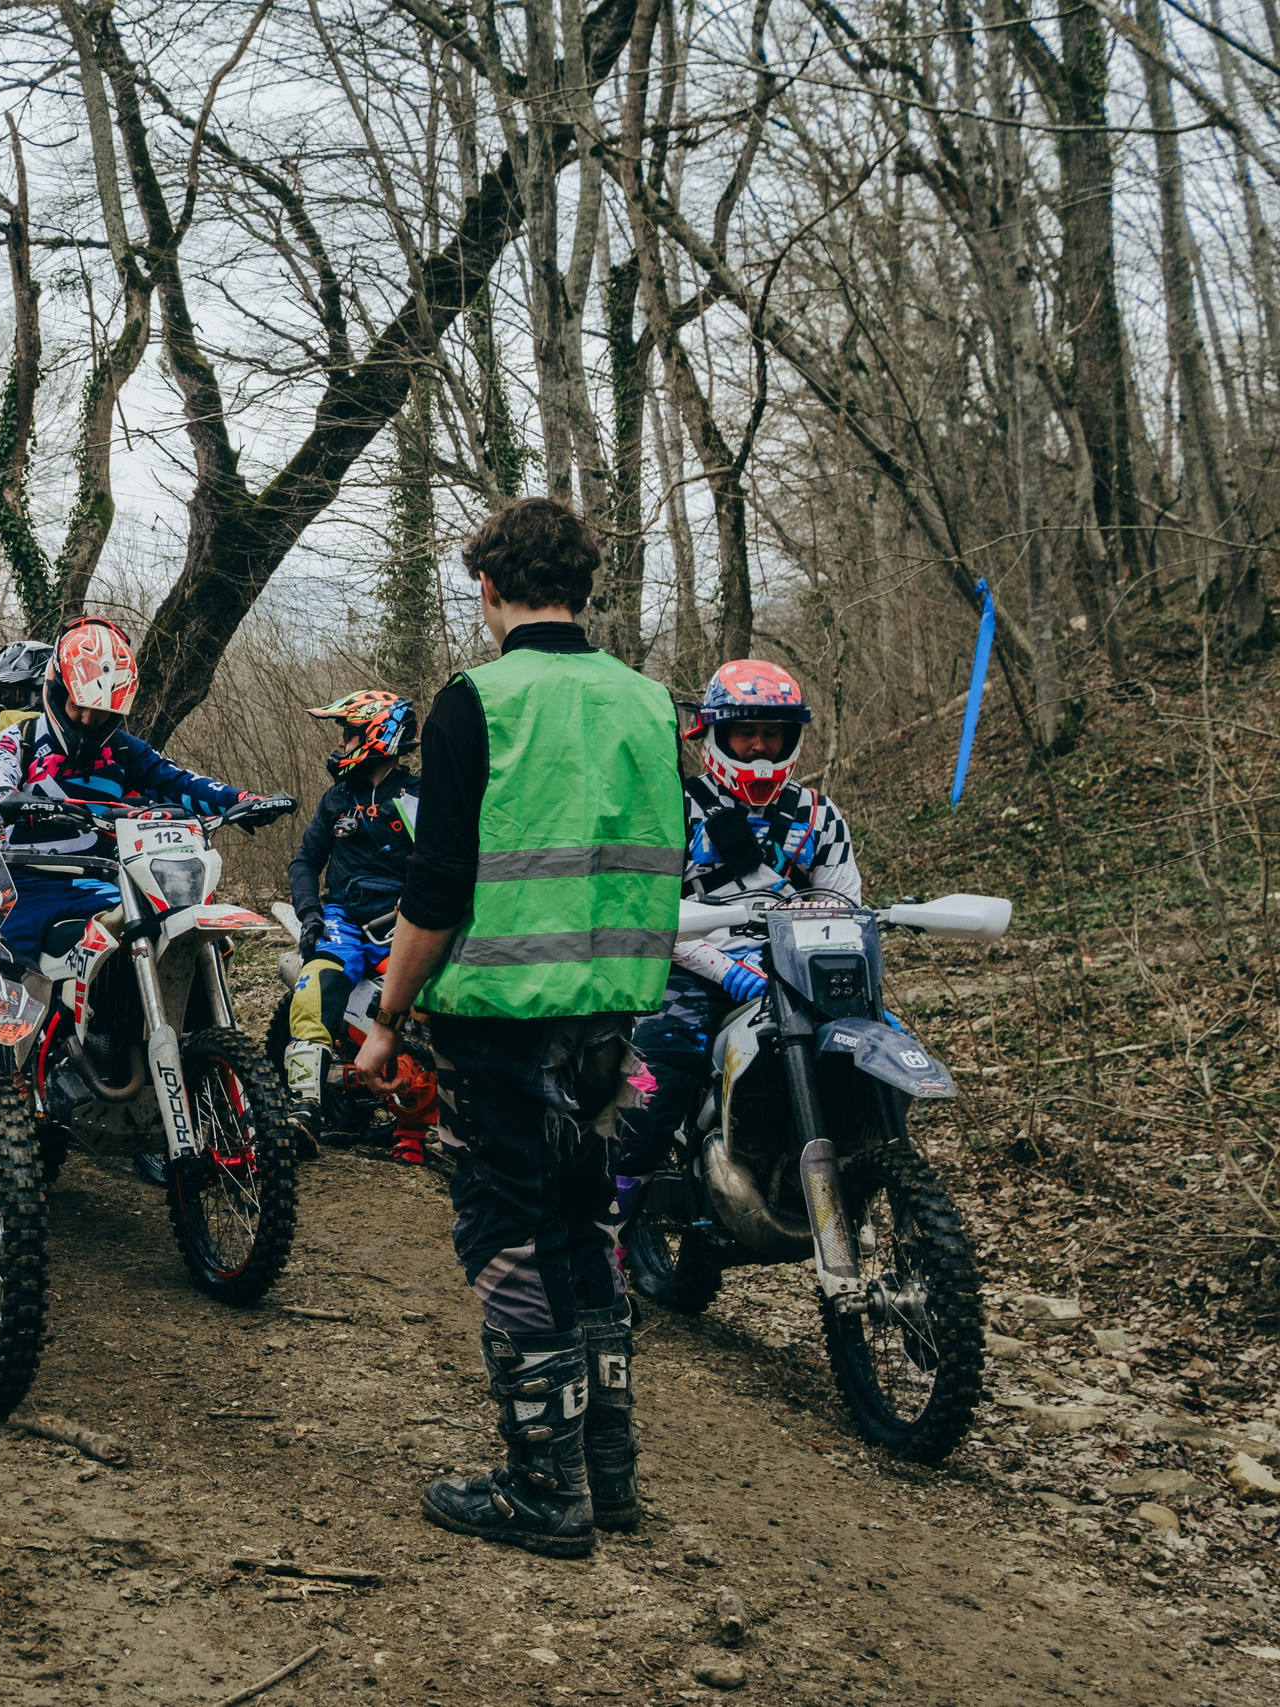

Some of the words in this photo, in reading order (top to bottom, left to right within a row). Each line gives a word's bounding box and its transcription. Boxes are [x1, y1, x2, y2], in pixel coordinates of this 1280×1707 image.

[716, 708, 758, 720] LEATT
[21, 803, 64, 812] ACERBS
[252, 800, 292, 811] ACERBIS
[154, 831, 183, 844] 112
[821, 925, 831, 940] 1
[832, 1032, 860, 1048] MOTOREX
[156, 1060, 191, 1145] ROCKOT
